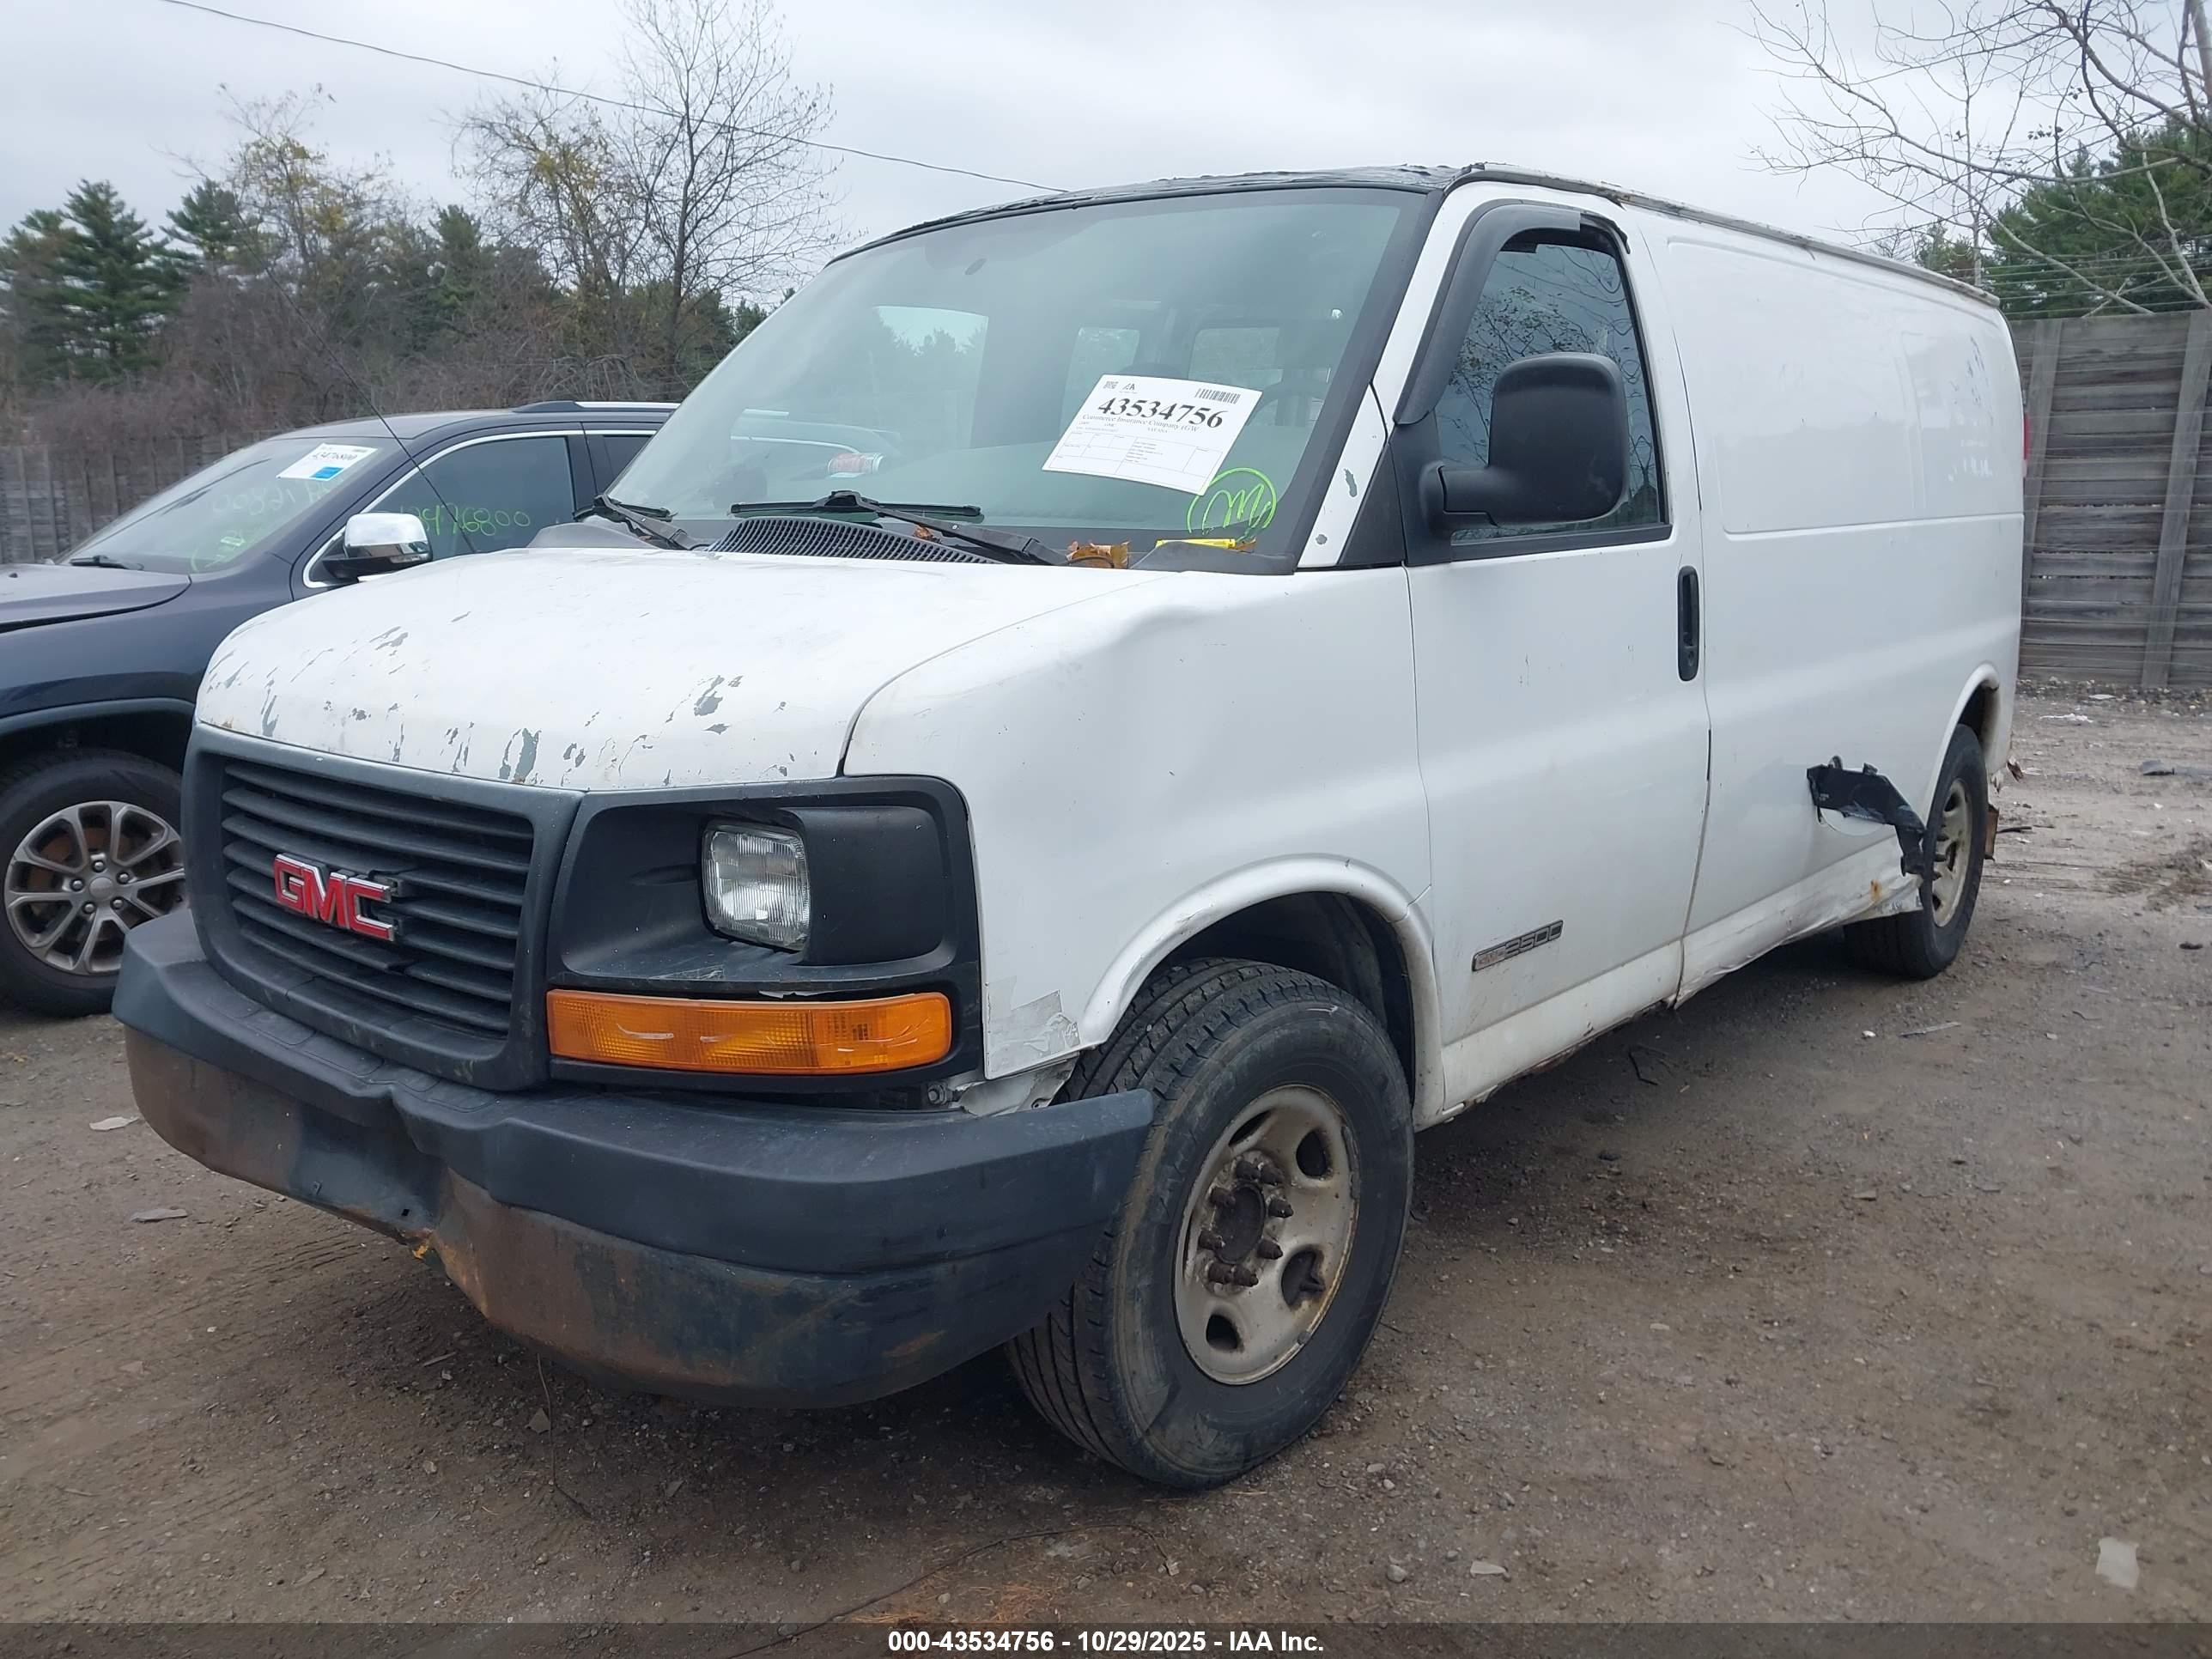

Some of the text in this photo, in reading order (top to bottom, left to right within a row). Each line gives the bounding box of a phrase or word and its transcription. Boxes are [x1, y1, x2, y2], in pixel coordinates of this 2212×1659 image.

[1097, 398, 1228, 428] 43534756
[274, 854, 394, 942] GMC
[1504, 921, 1563, 957] 2500
